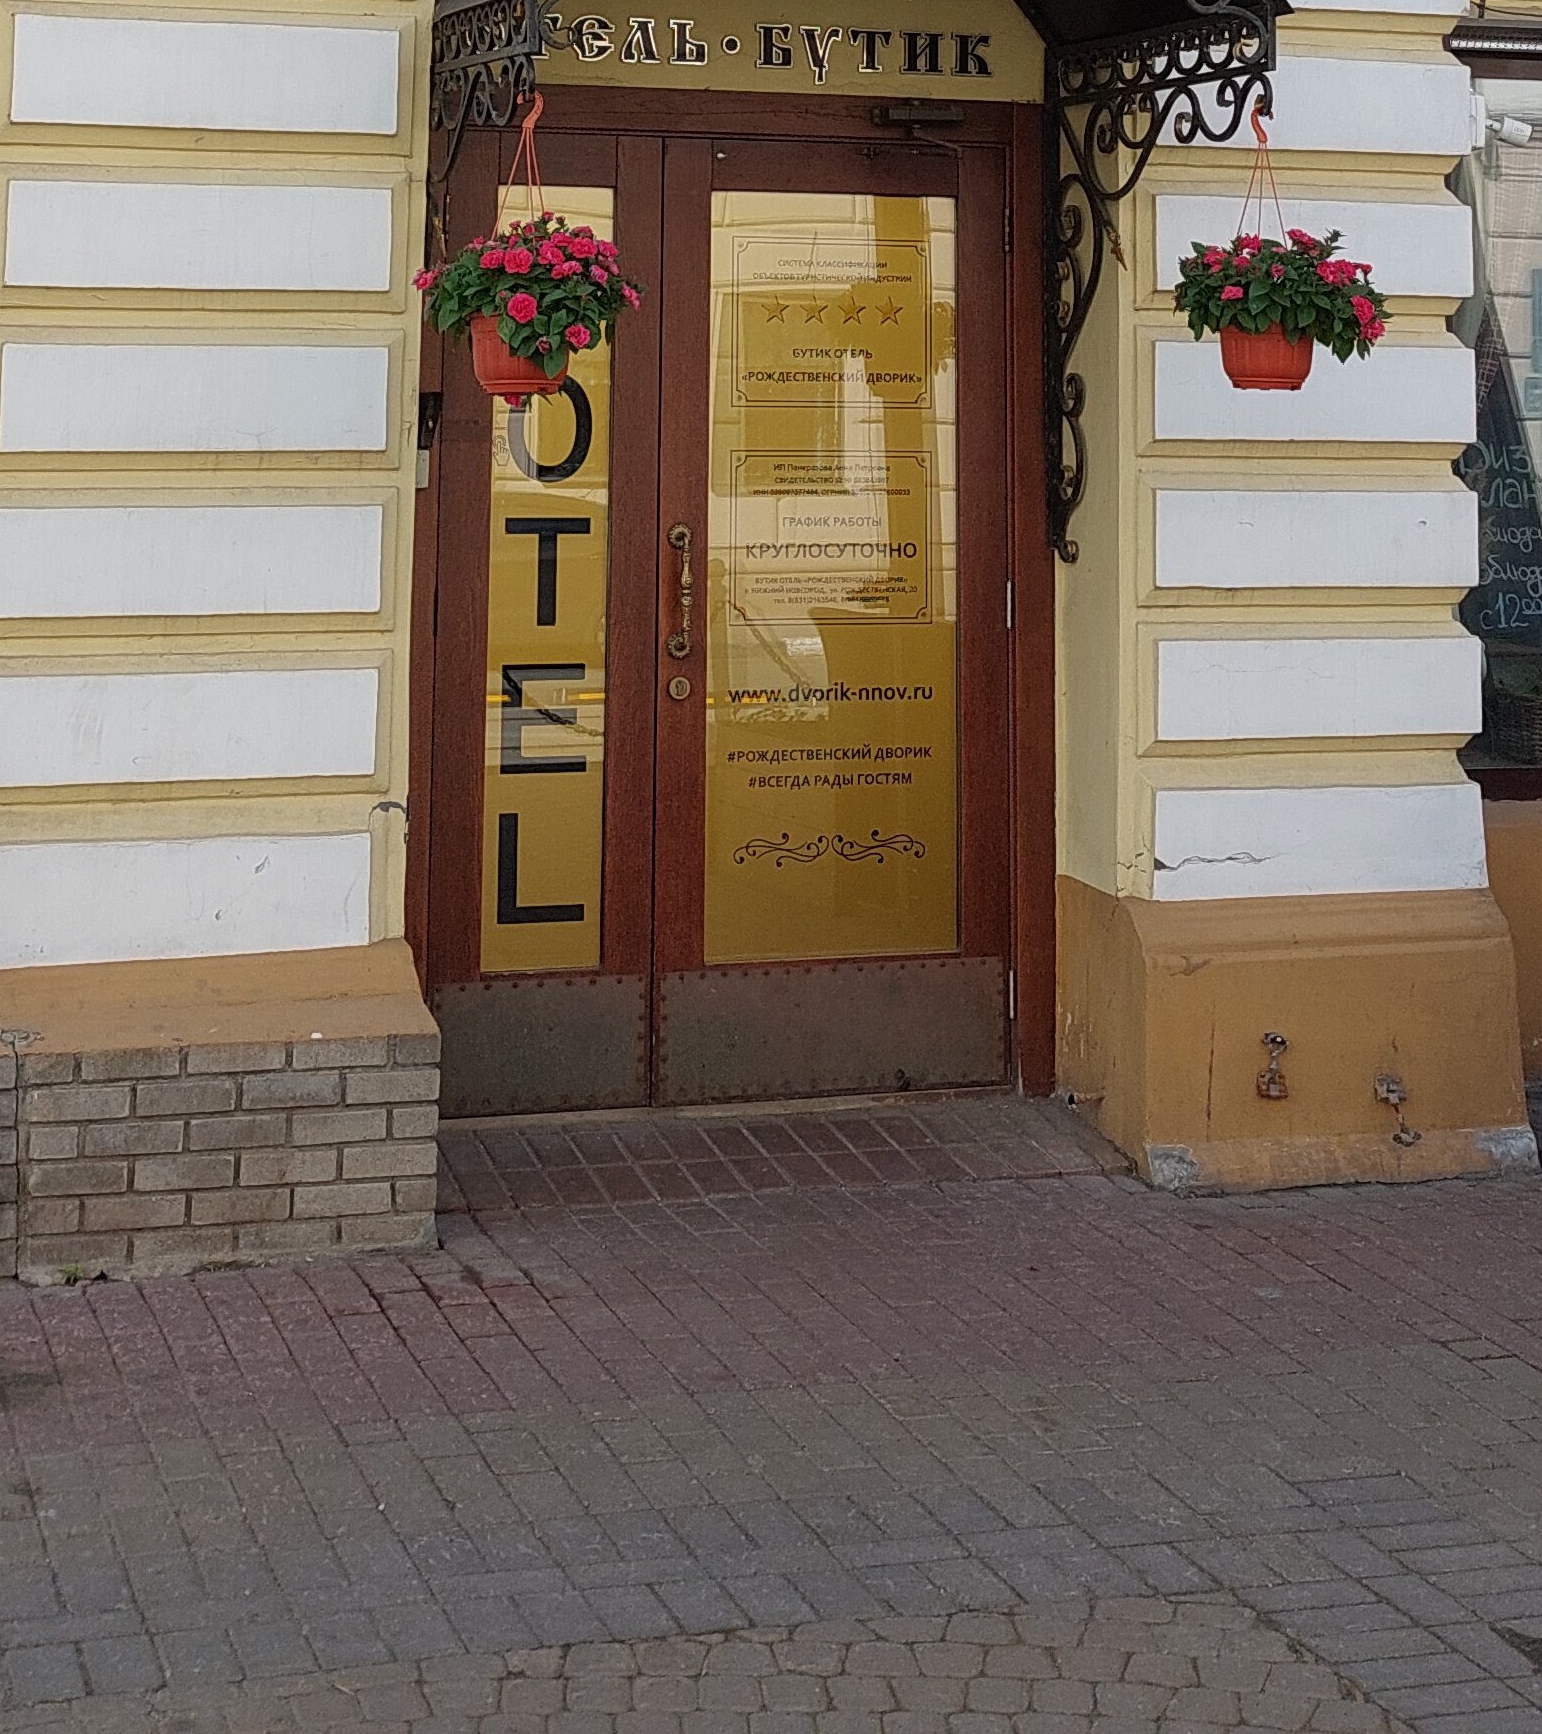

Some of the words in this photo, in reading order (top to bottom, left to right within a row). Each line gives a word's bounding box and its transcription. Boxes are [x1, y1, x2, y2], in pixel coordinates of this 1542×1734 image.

[777, 259, 814, 268] СИСТЕМА
[816, 260, 888, 270] КЛАССИФИКАЦИИ
[792, 348, 832, 360] БУТИК
[833, 348, 873, 360] ОТЕЛЬ
[741, 369, 864, 384] «РОЖДЕСТВЕНСКИЙ
[866, 372, 923, 385] ДВОРИК»
[782, 516, 830, 528] ГРАФИК
[833, 516, 882, 527] РАБОТЫ
[745, 542, 917, 559] КРУГЛОСУТОЧНО
[728, 681, 933, 704] www.dvorik-nnov.ru
[727, 744, 872, 765] #РОЖДЕСТВЕНСКИЙ
[874, 746, 932, 762] ДВОРИК
[748, 774, 810, 791] #ВСЕГДА
[814, 774, 853, 790] РАДЫ
[857, 772, 913, 786] ГОСТЯМ
